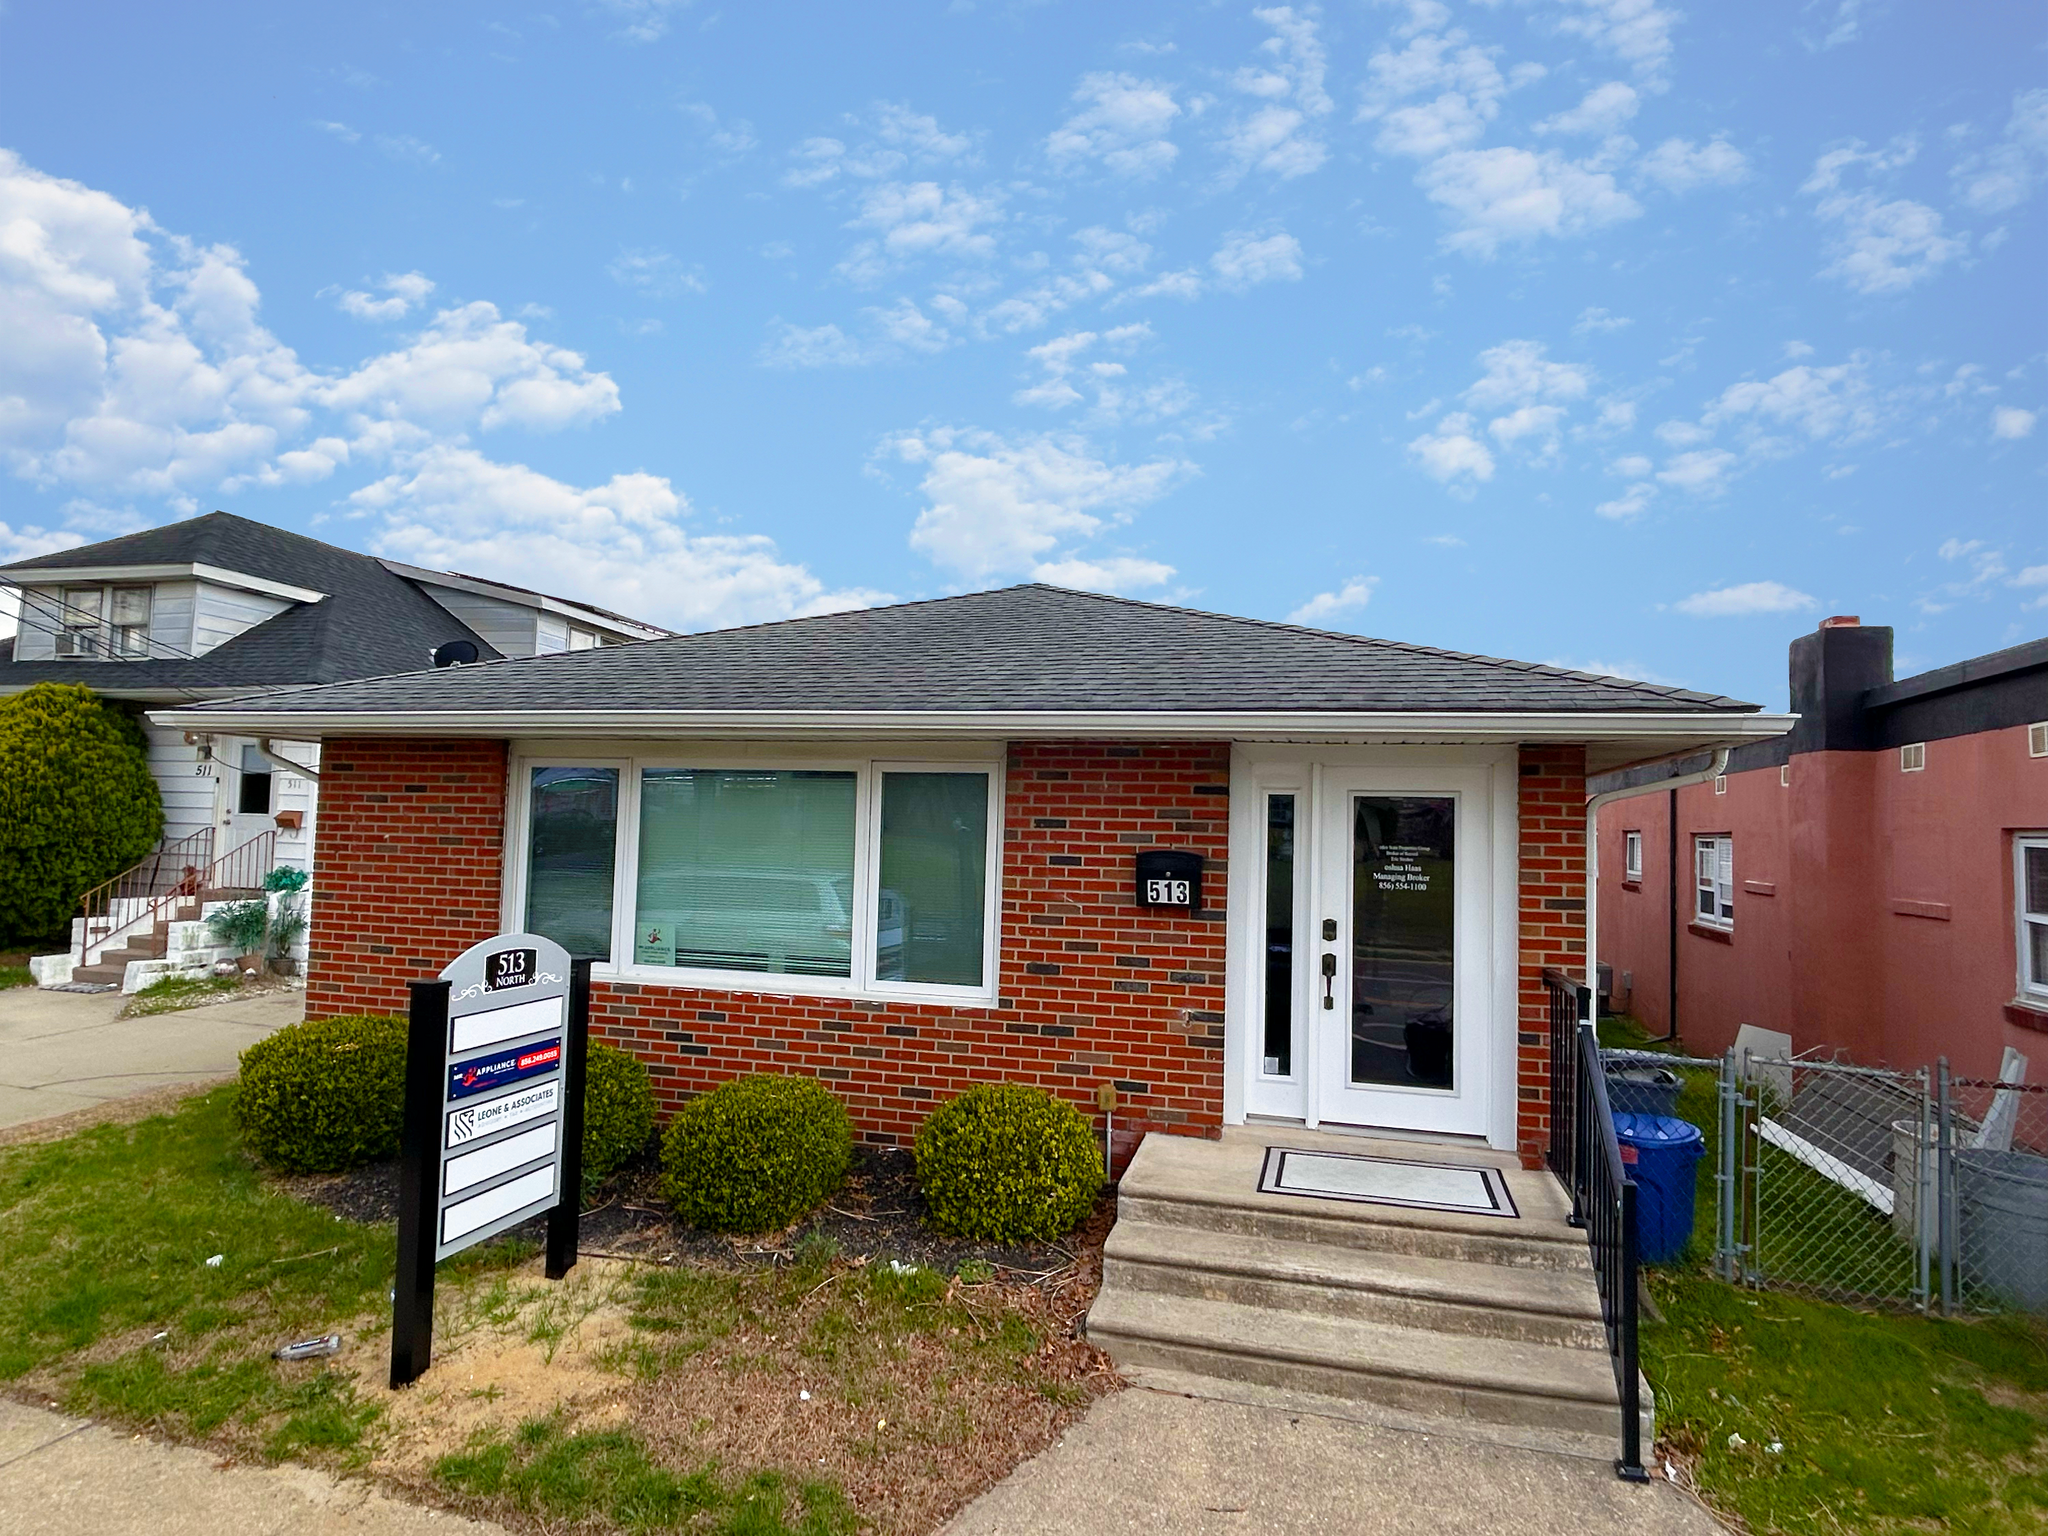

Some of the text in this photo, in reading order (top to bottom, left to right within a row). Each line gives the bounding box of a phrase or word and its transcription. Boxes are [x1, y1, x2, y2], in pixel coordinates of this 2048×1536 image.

[195, 764, 213, 777] 511
[1405, 864, 1422, 872] Haas
[1373, 872, 1430, 882] Managing Broker
[1149, 881, 1188, 903] 513
[497, 951, 525, 976] 513
[495, 973, 526, 988] NORTH
[476, 1059, 516, 1076] APPLIANCE
[477, 1088, 554, 1122] LEONE & ASSOCIATES
